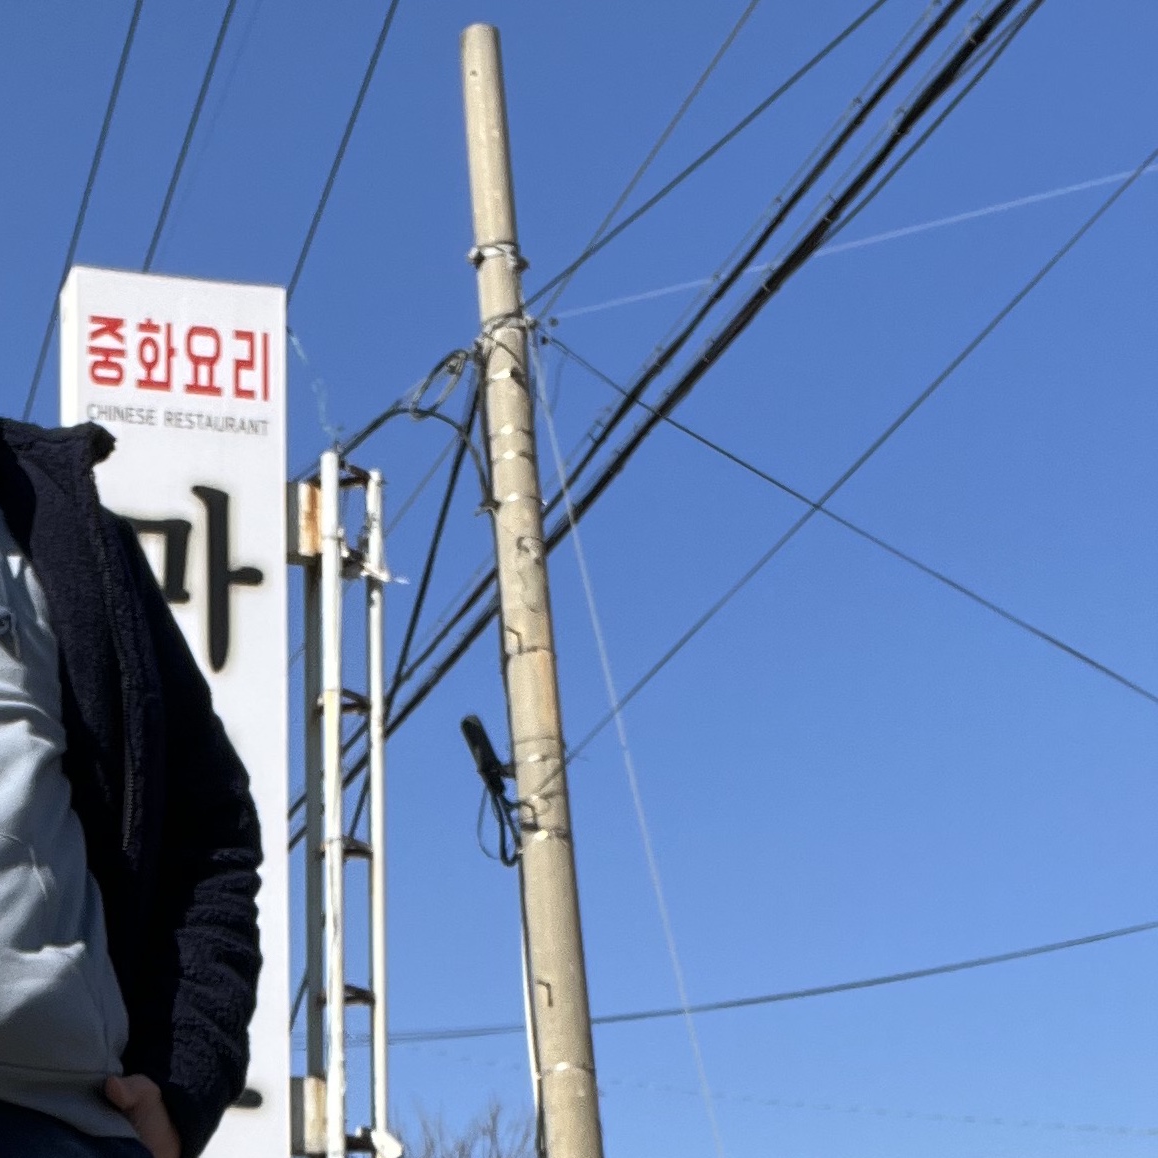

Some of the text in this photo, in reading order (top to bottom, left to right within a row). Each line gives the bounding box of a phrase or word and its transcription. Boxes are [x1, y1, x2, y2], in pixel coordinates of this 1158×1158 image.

[87, 315, 270, 402] 중화요리
[87, 403, 270, 436] CHINESE RESTAURANT
